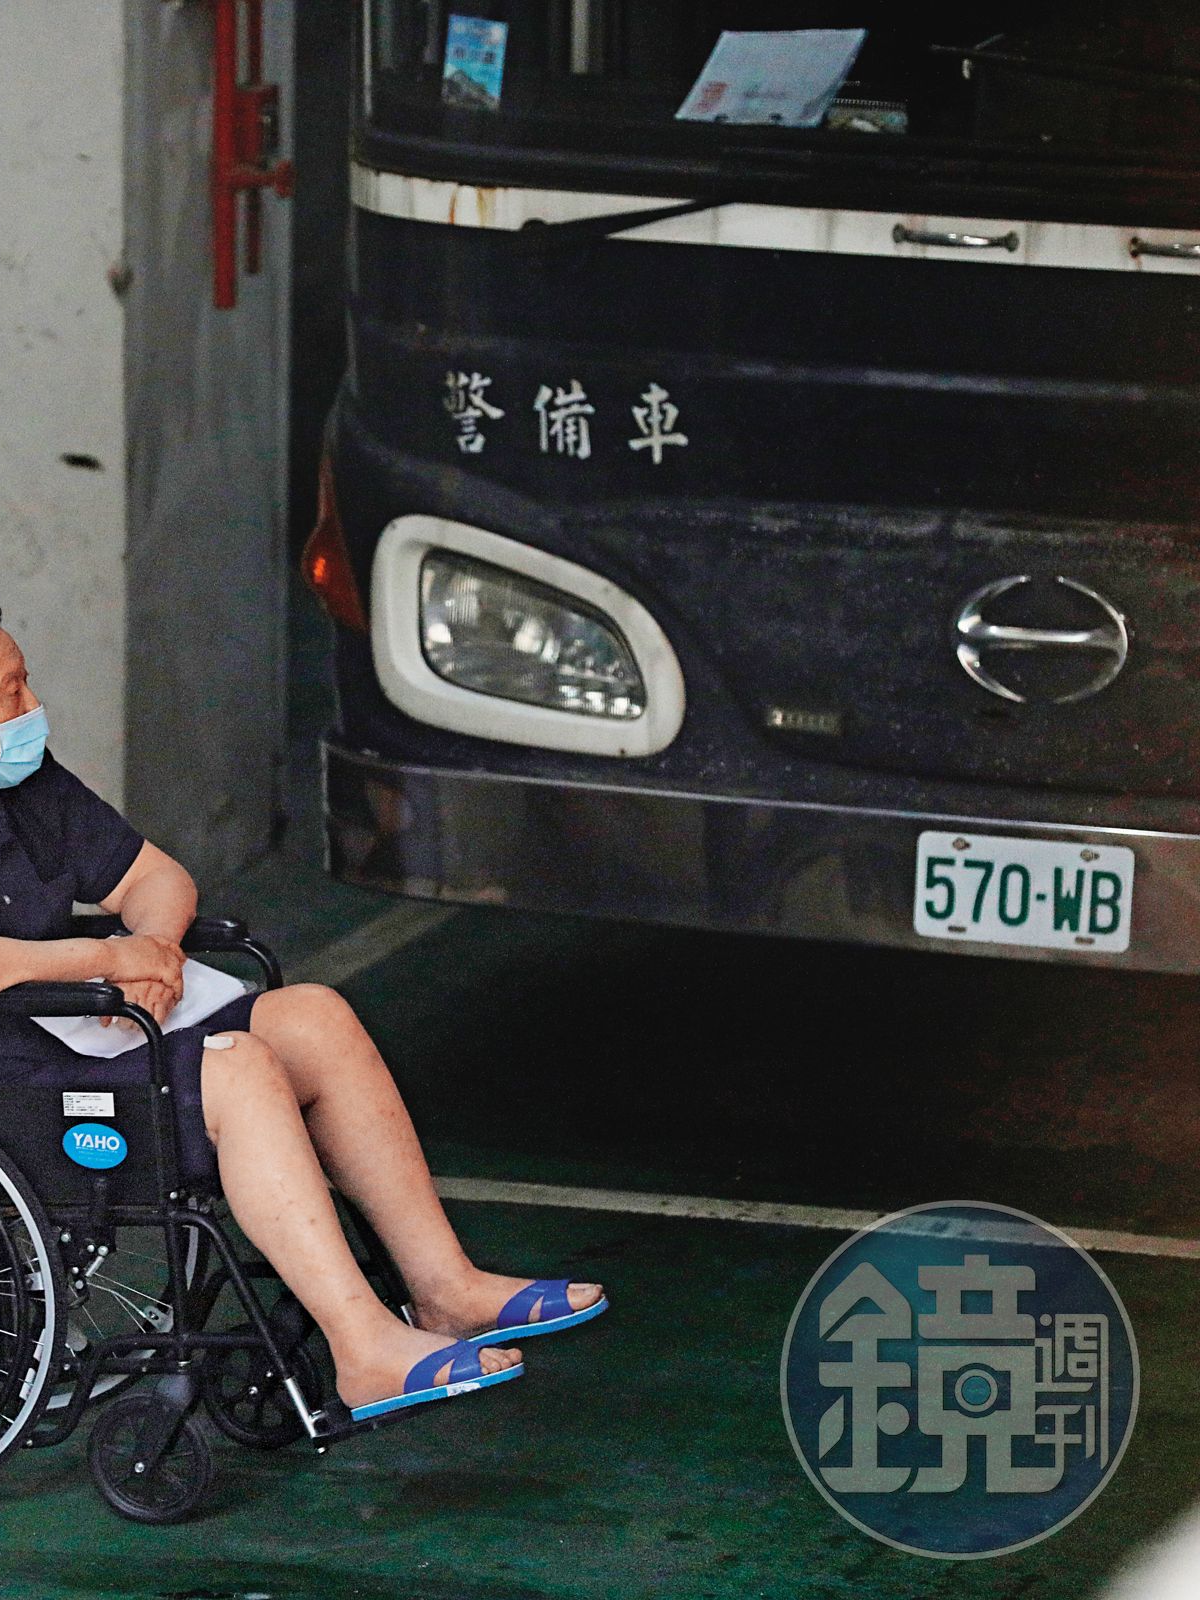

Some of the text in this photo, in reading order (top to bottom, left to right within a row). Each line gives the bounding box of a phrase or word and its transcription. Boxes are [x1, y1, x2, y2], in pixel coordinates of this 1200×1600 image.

[443, 371, 689, 465] 警備車
[925, 856, 1122, 935] 570-WB
[72, 1132, 120, 1151] YAHO
